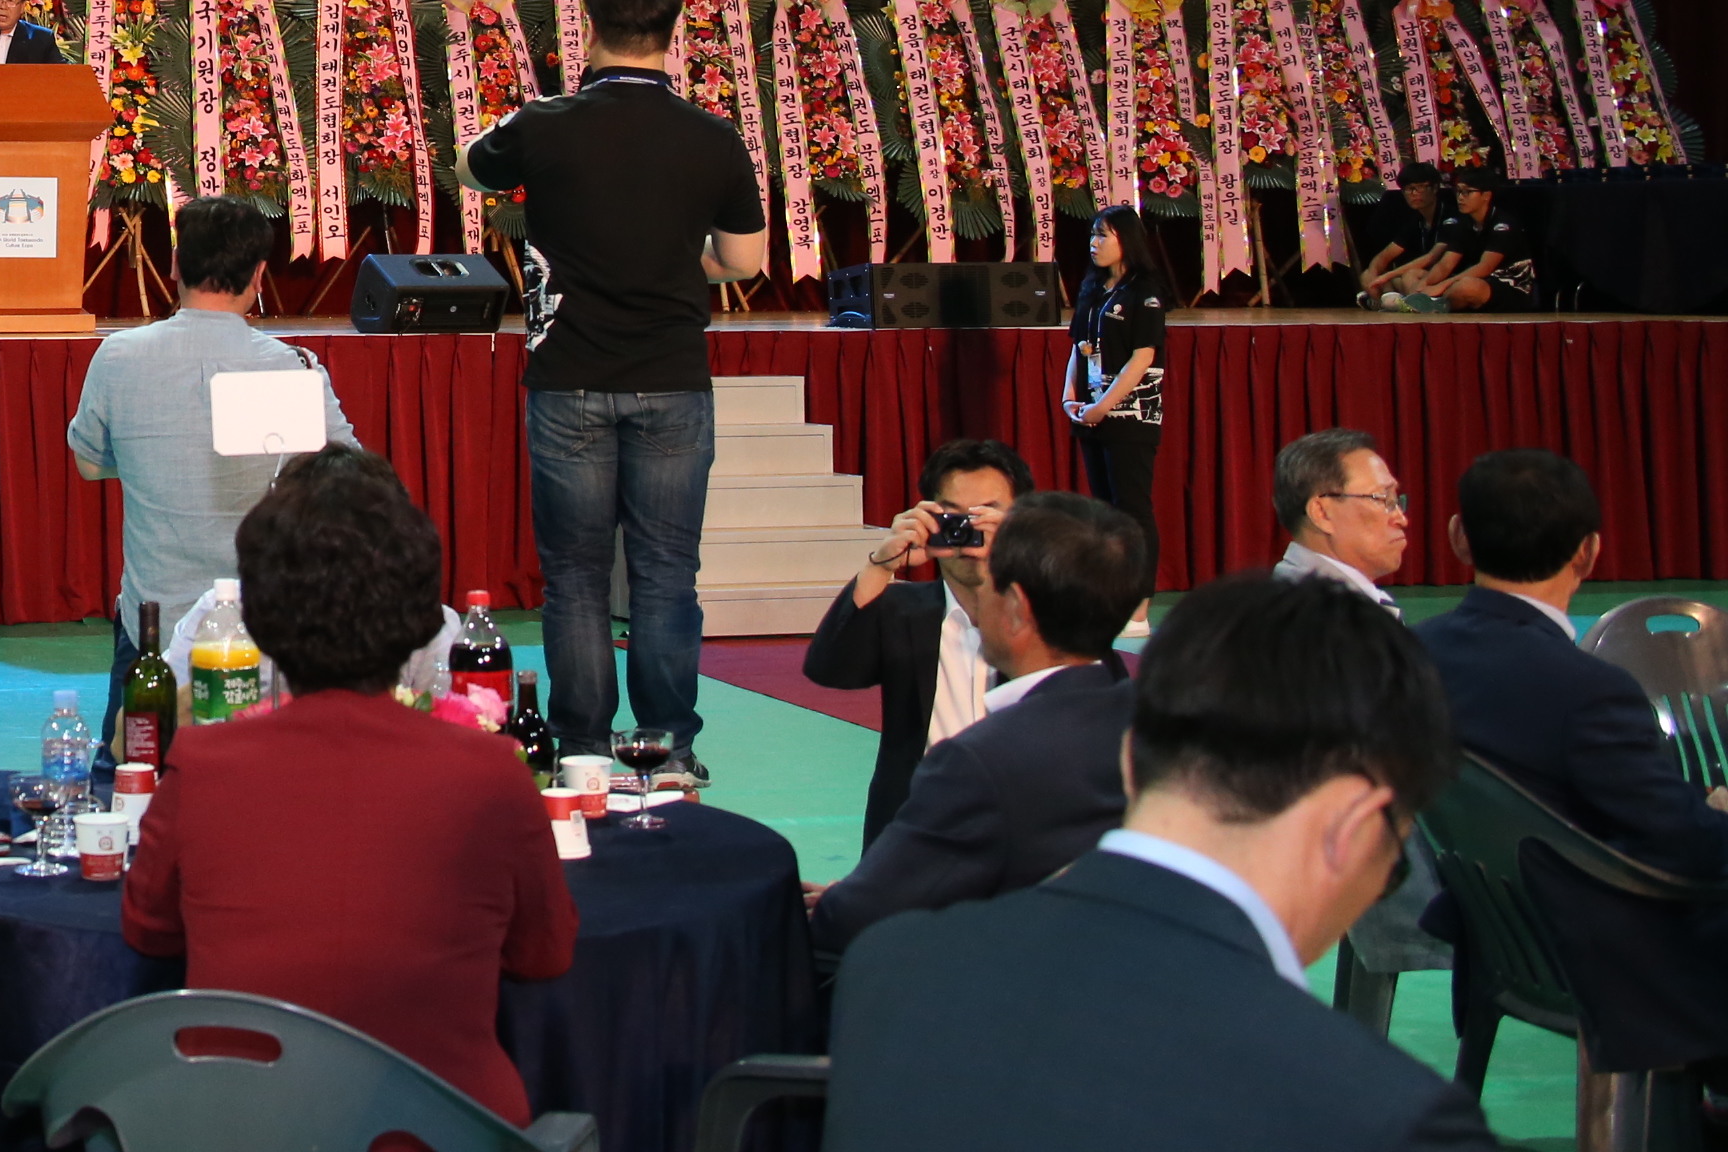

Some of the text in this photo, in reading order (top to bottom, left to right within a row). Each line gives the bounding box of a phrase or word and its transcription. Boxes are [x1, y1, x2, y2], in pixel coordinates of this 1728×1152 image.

[321, 3, 340, 54] 김제시
[773, 20, 792, 71] 서울시
[899, 14, 924, 65] 정읍시
[1001, 26, 1026, 75] 군산시
[194, 0, 218, 115] 국기원장
[909, 67, 938, 152] 태권도협회
